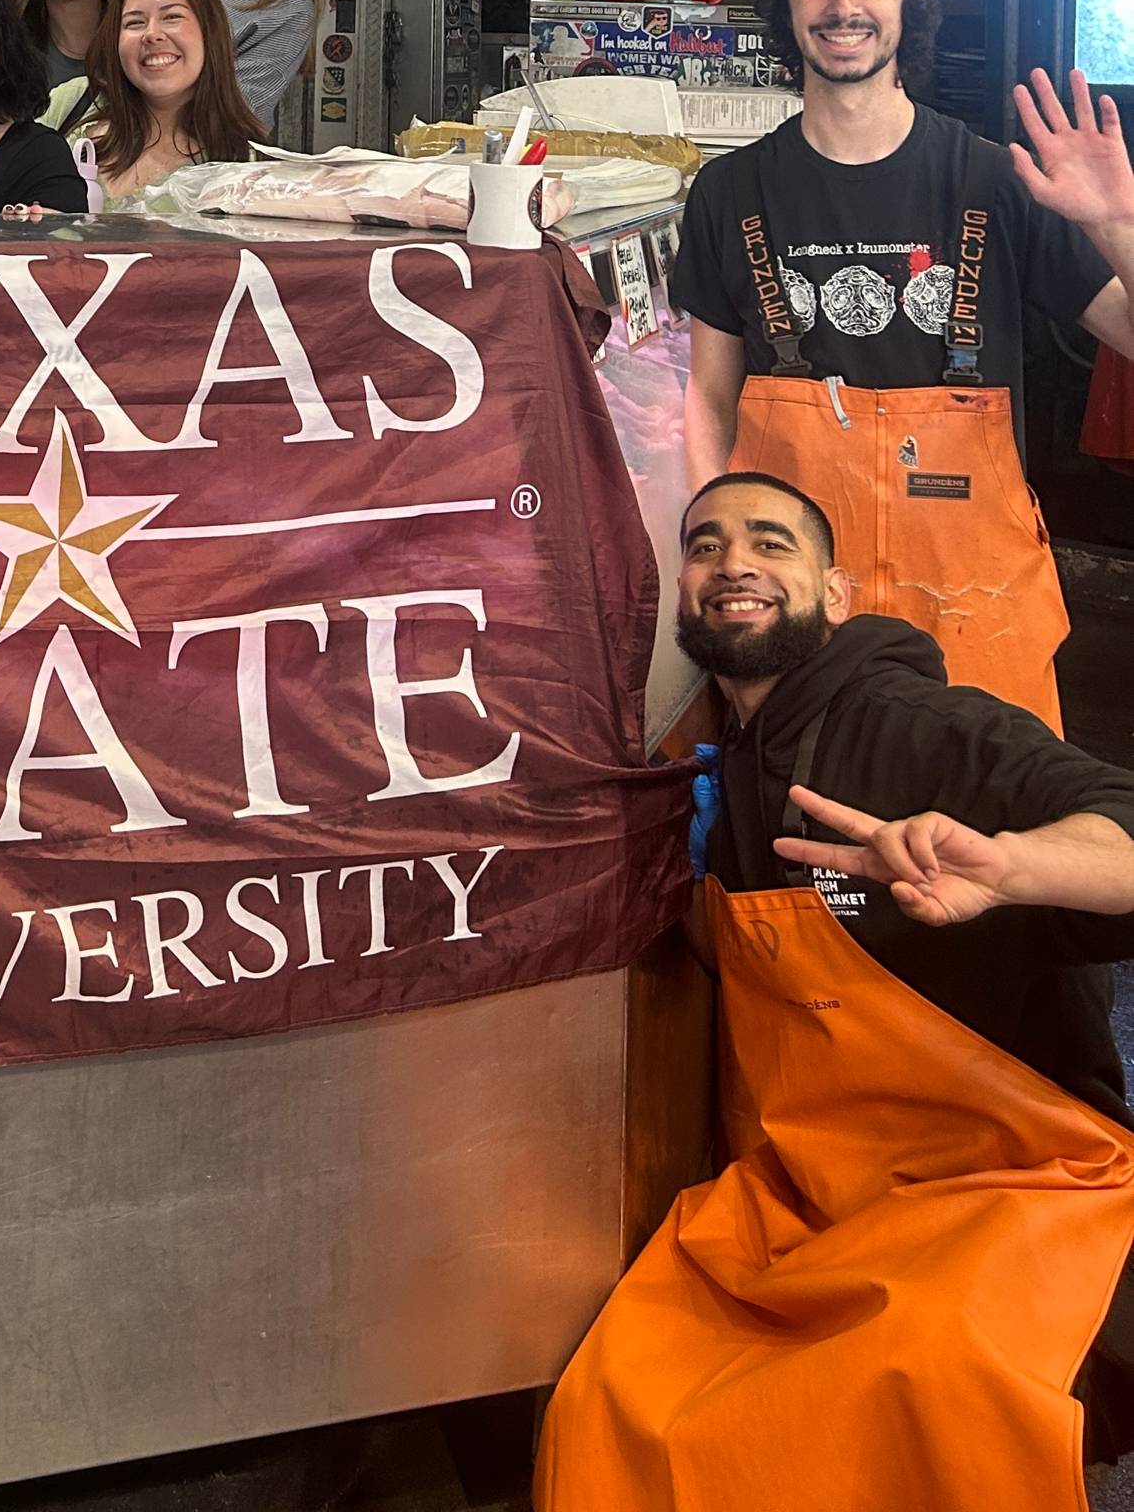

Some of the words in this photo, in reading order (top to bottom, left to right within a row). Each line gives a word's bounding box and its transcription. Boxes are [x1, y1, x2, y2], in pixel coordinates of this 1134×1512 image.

[617, 36, 652, 51] hooked
[655, 40, 667, 52] on
[788, 244, 842, 257] Longneck
[857, 242, 930, 254] Izumonster
[814, 880, 839, 892] FISH
[826, 893, 866, 905] ARKET
